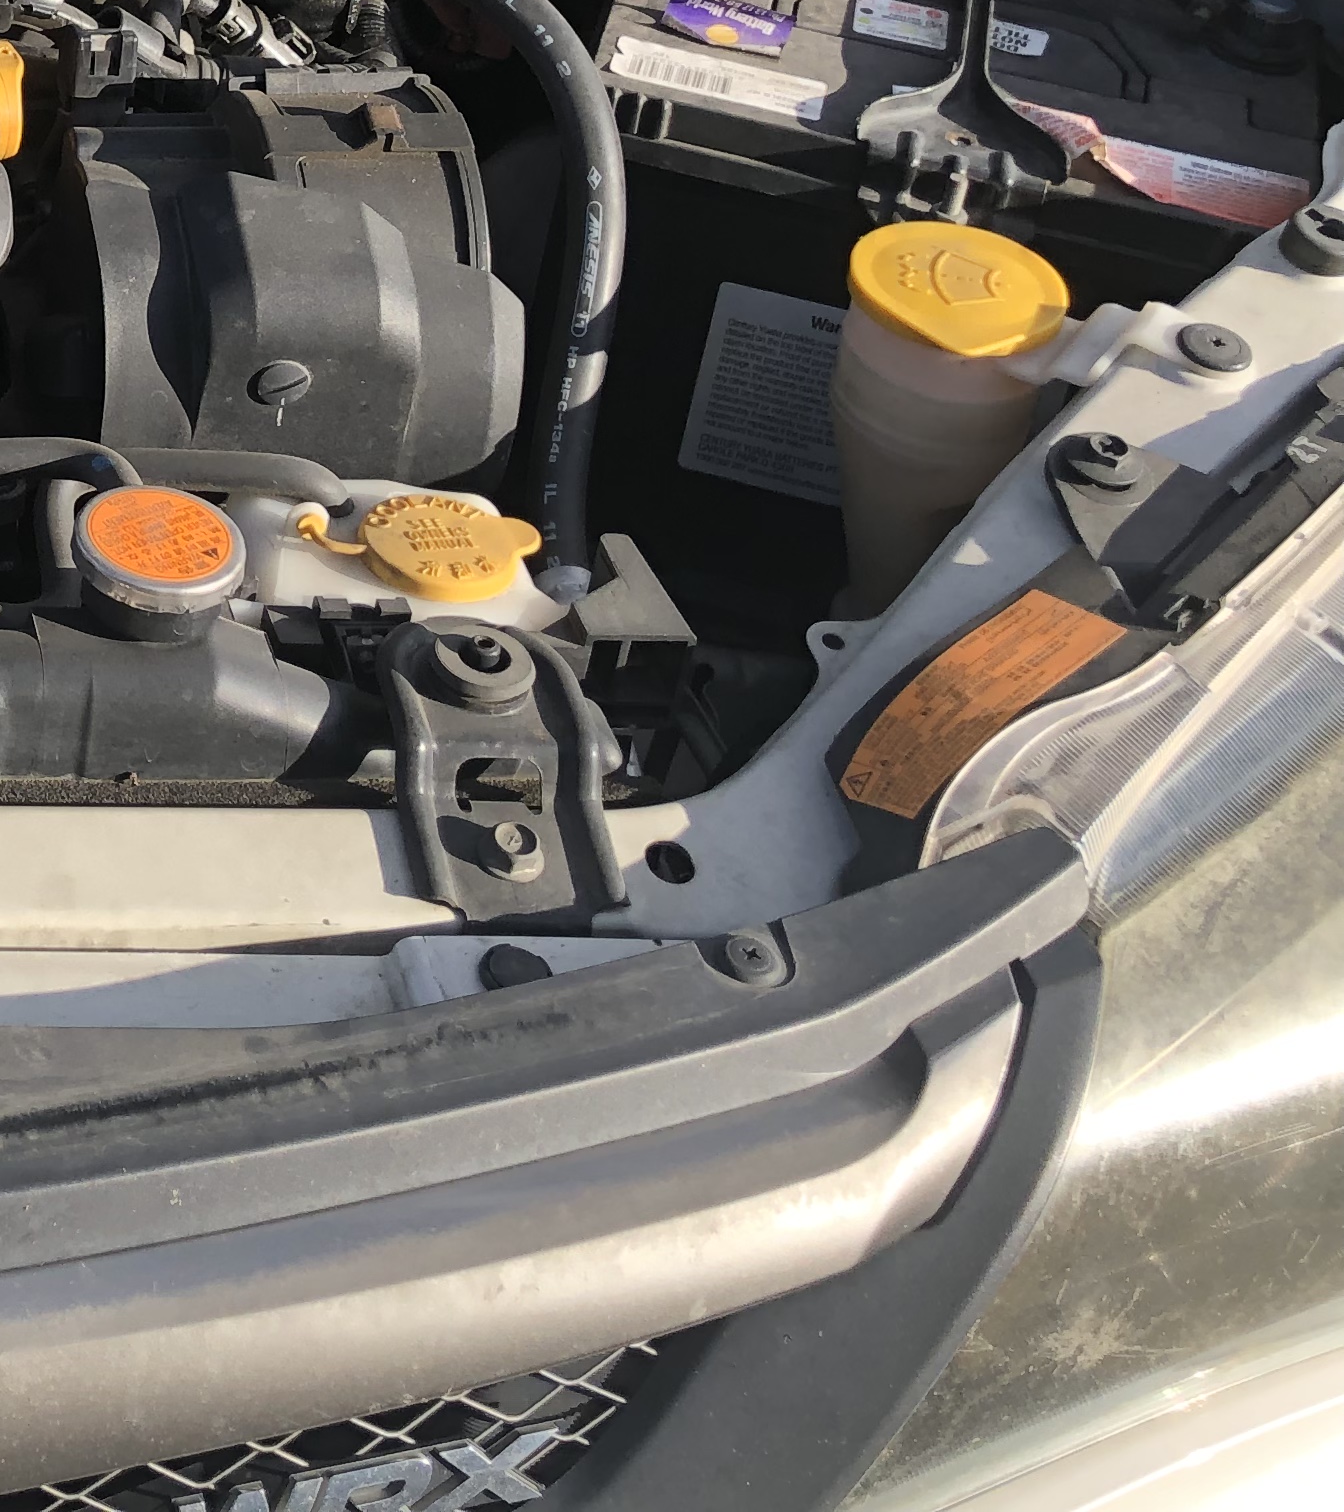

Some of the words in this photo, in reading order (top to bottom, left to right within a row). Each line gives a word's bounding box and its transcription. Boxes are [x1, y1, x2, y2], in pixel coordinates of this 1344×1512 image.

[723, 6, 778, 36] Battery
[811, 315, 842, 334] War
[567, 345, 579, 369] HP
[548, 377, 573, 463] HFC-134a
[365, 496, 486, 529] COOLANT
[406, 518, 444, 531] SEE
